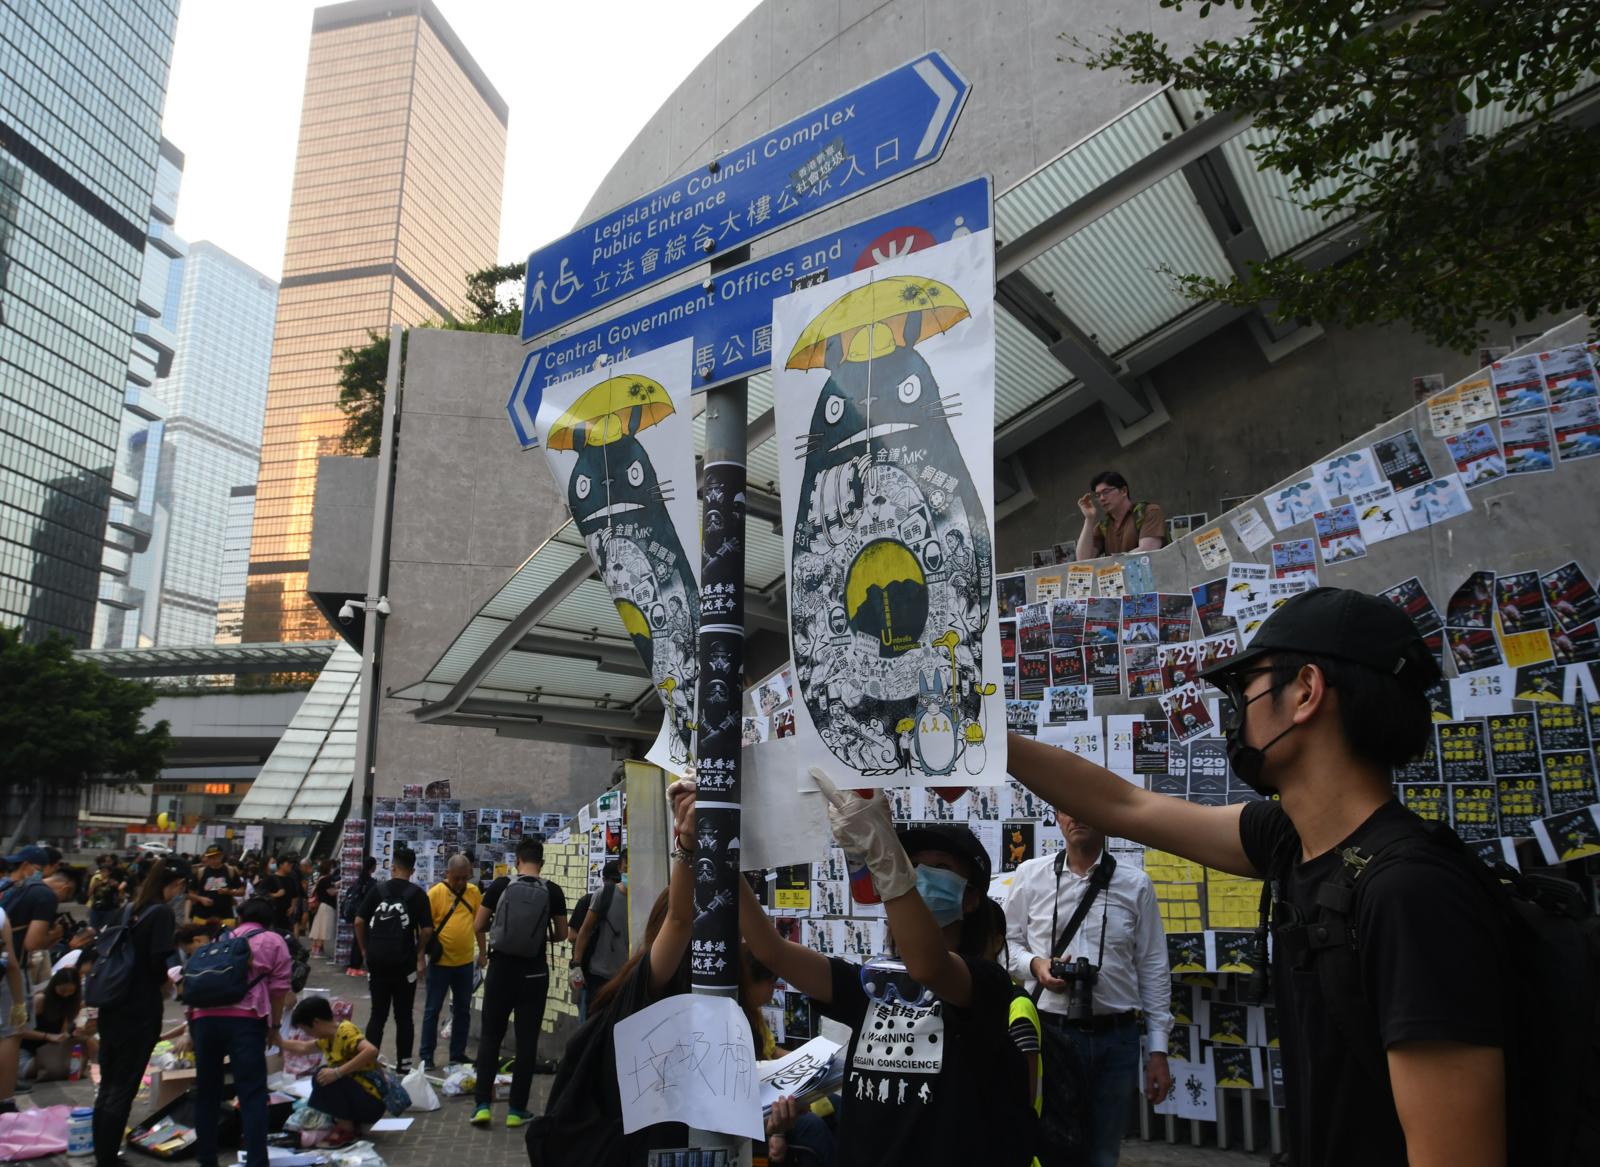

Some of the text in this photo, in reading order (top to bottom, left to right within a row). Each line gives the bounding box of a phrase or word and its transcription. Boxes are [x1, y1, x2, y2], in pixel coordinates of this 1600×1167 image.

[595, 104, 856, 243] Legislative Council Complex
[592, 190, 726, 265] Public Entrance
[545, 332, 602, 370] Central
[608, 292, 715, 344] Government
[721, 264, 795, 301] Offices
[801, 239, 842, 270] and
[544, 347, 632, 387] Tamar ark
[903, 449, 924, 465] MK
[635, 527, 651, 539] MK
[795, 531, 809, 547] 831
[844, 535, 860, 558] 689
[1174, 646, 1197, 665] 29
[1215, 640, 1237, 658] 29
[1176, 688, 1199, 709] 29
[1470, 686, 1501, 696] 219
[1074, 744, 1098, 753] 219
[1169, 758, 1186, 767] 29
[1192, 757, 1226, 767] 929
[692, 940, 727, 952] 復香港
[692, 956, 727, 972] 代革命
[873, 1003, 940, 1021] 告重拾良知
[868, 1032, 915, 1044] WARNING
[853, 1056, 940, 1070] REGAIN CONSCIENCE
